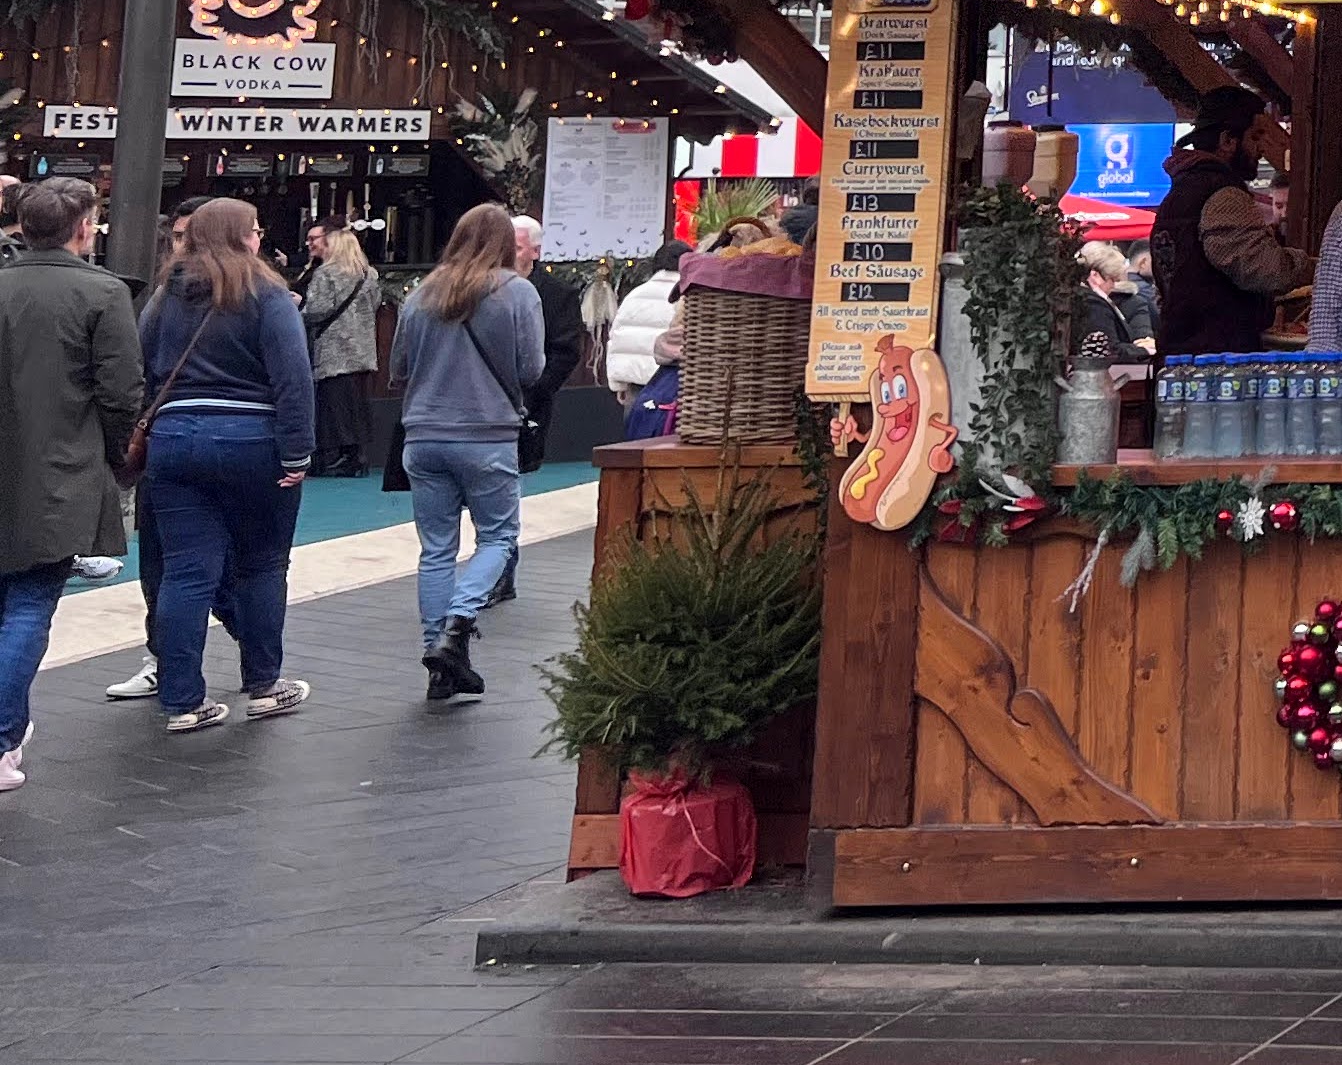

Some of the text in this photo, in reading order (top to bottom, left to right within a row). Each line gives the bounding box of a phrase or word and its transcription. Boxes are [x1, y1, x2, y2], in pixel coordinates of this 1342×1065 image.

[859, 15, 928, 28] Bratwurst
[865, 42, 893, 60] £11
[182, 54, 327, 72] BLACK COW
[225, 79, 282, 91] VODKA
[860, 91, 885, 107] £11
[54, 113, 424, 134] FEST WINTER WARMERS
[834, 113, 940, 128] Kasebockwurst
[855, 141, 878, 158] £11
[842, 162, 925, 178] Currywurst
[1098, 170, 1134, 190] global
[851, 195, 878, 212] £13
[842, 216, 919, 230] Frankfurter
[852, 243, 884, 261] £10
[830, 264, 862, 278] Beef
[848, 283, 875, 301] £12
[816, 306, 829, 316] All
[832, 306, 858, 316] served
